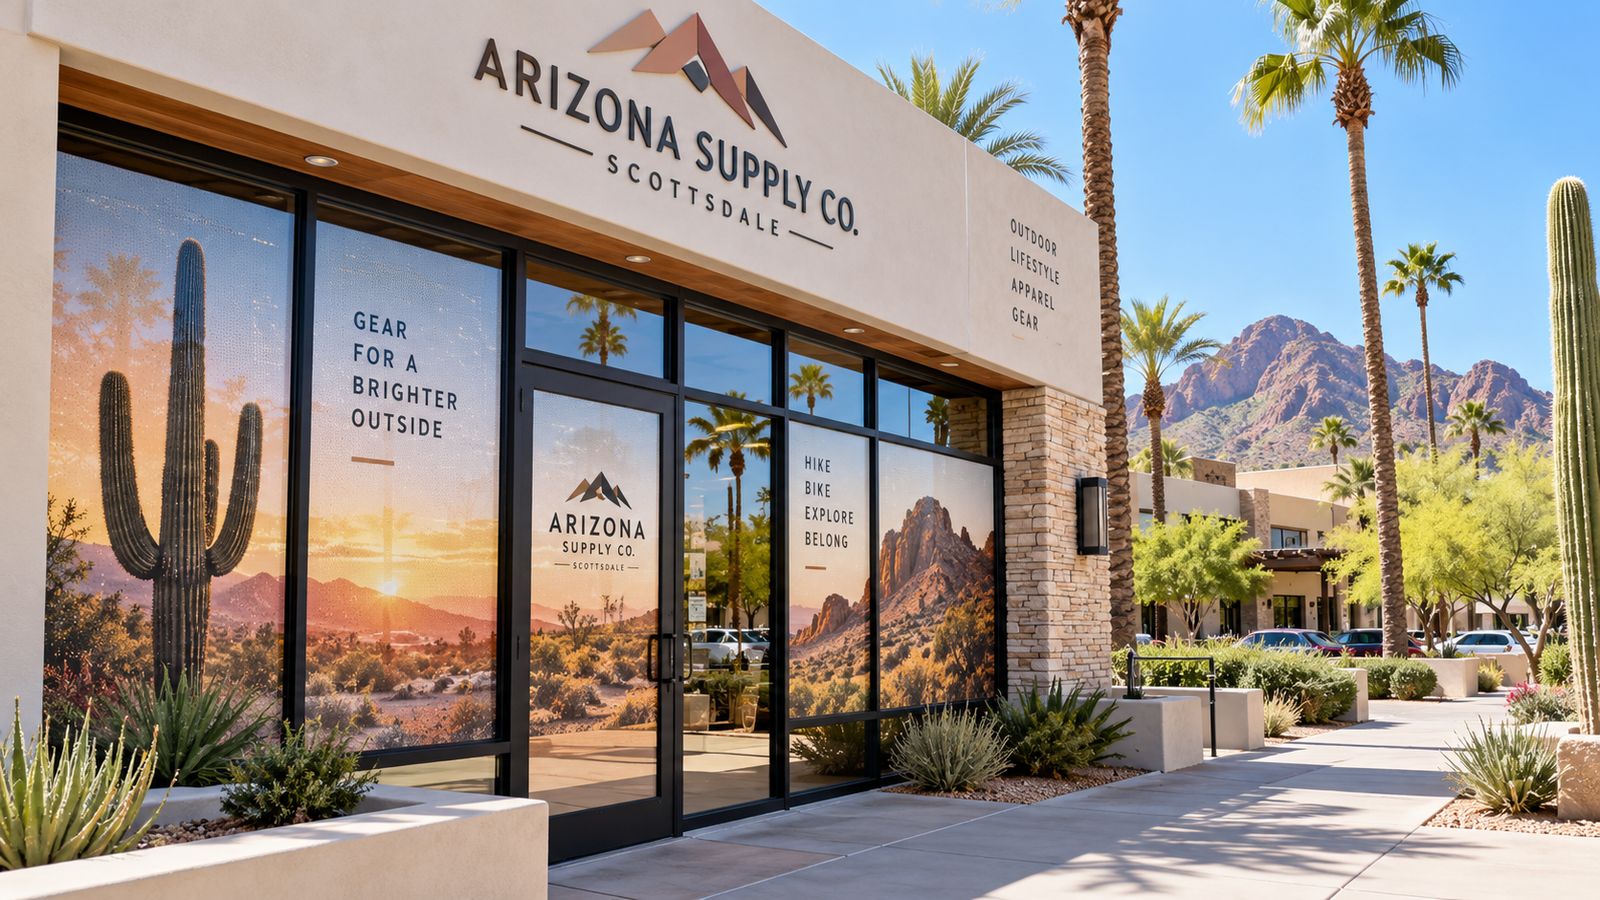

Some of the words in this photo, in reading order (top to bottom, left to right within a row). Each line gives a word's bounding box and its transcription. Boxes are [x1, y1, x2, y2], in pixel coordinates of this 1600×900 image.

[474, 38, 681, 161] ARIZONA
[695, 130, 812, 214] SUPPLY
[821, 188, 859, 237] CO.
[607, 154, 780, 237] SCOTTSDALE
[1010, 218, 1057, 257] OUTDOOR
[1010, 246, 1060, 285] LIFESTYLE
[1011, 277, 1055, 311] APPAREL
[353, 311, 407, 340] GEAR
[1012, 306, 1039, 332] GEAR
[353, 343, 394, 369] FOR
[405, 354, 418, 373] A
[353, 375, 458, 411] BRIGHTER
[351, 408, 443, 439] OUTSIDE
[804, 455, 831, 474] HIKE
[805, 480, 831, 498] BIKE
[548, 511, 646, 540] ARIZONA
[805, 505, 854, 525] EXPLORE
[562, 540, 612, 556] SUPPLY
[617, 544, 635, 557] CO.
[805, 531, 849, 549] BELONG
[572, 561, 625, 571] SCOTTSDALE
